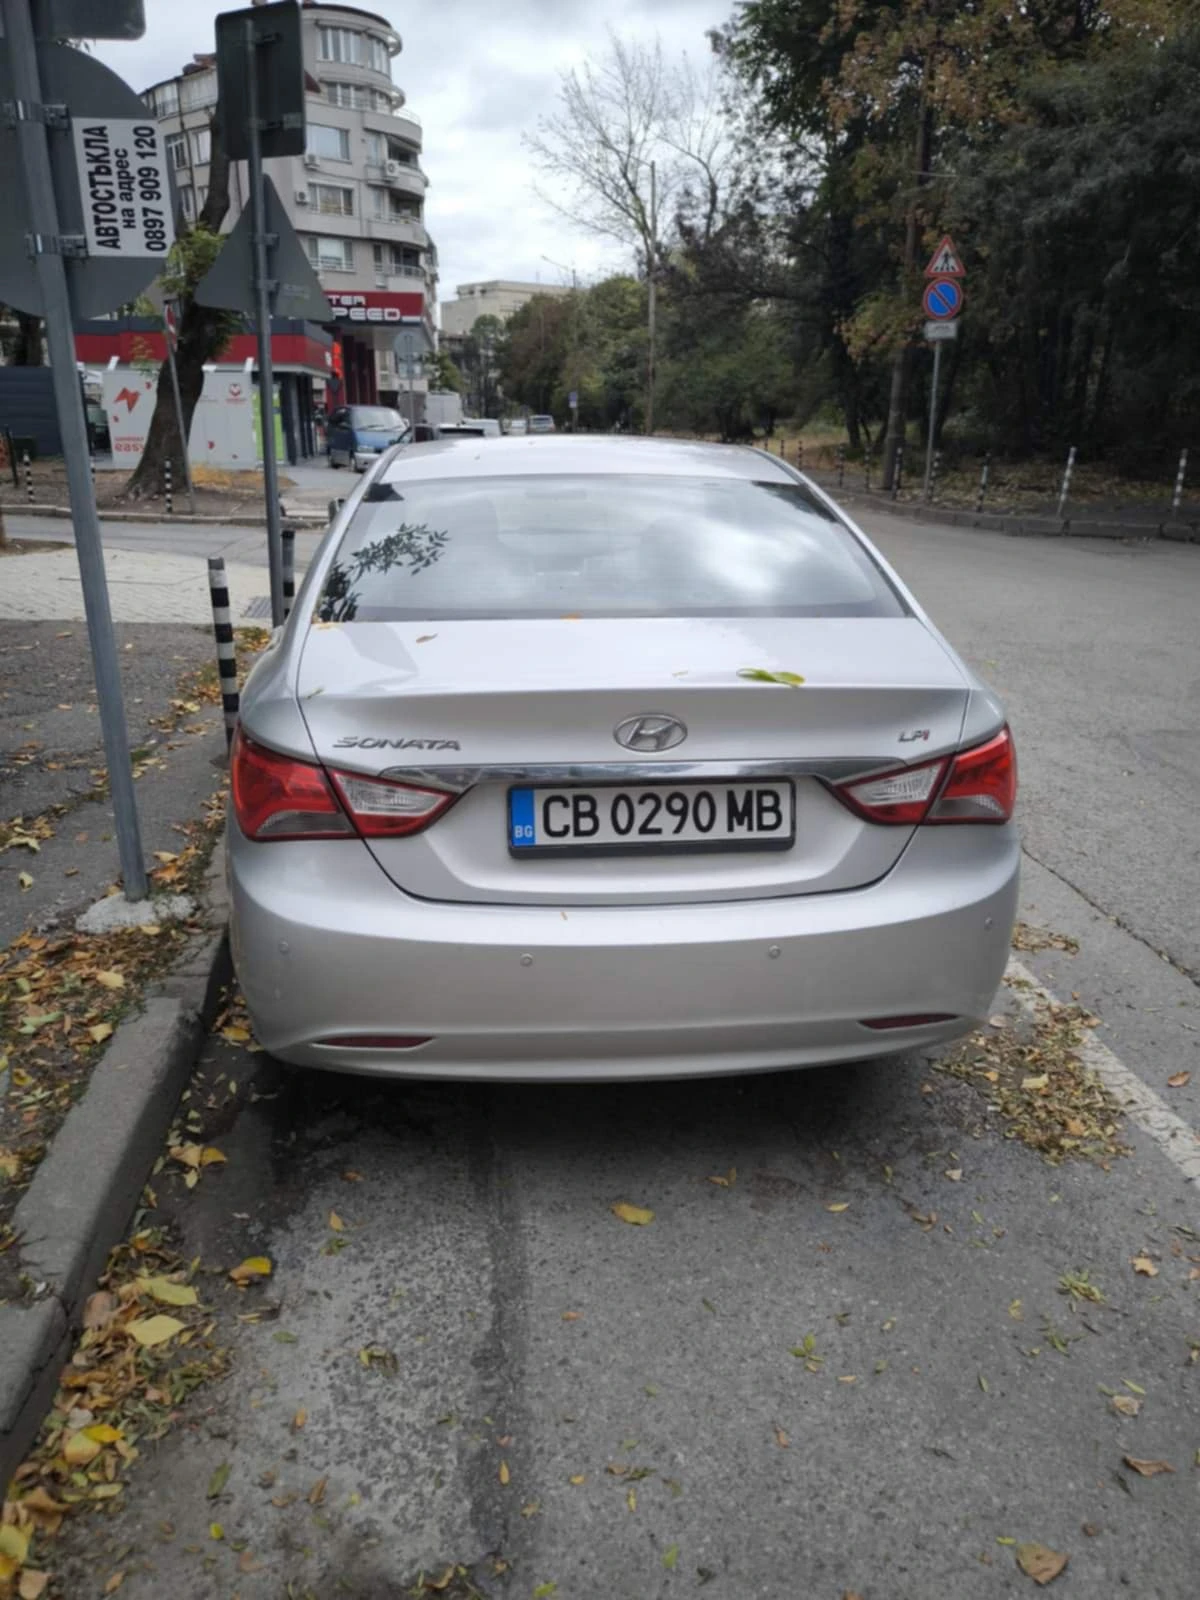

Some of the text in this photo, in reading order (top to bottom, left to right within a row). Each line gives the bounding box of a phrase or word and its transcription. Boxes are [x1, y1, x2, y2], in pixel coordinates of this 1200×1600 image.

[82, 125, 121, 249] АВТОСТЪКЛА
[114, 148, 136, 229] на адрес
[132, 125, 167, 252] 0897 909 120
[332, 736, 461, 751] SONATA
[514, 825, 533, 839] BG
[542, 789, 783, 838] CB 0290 MB
